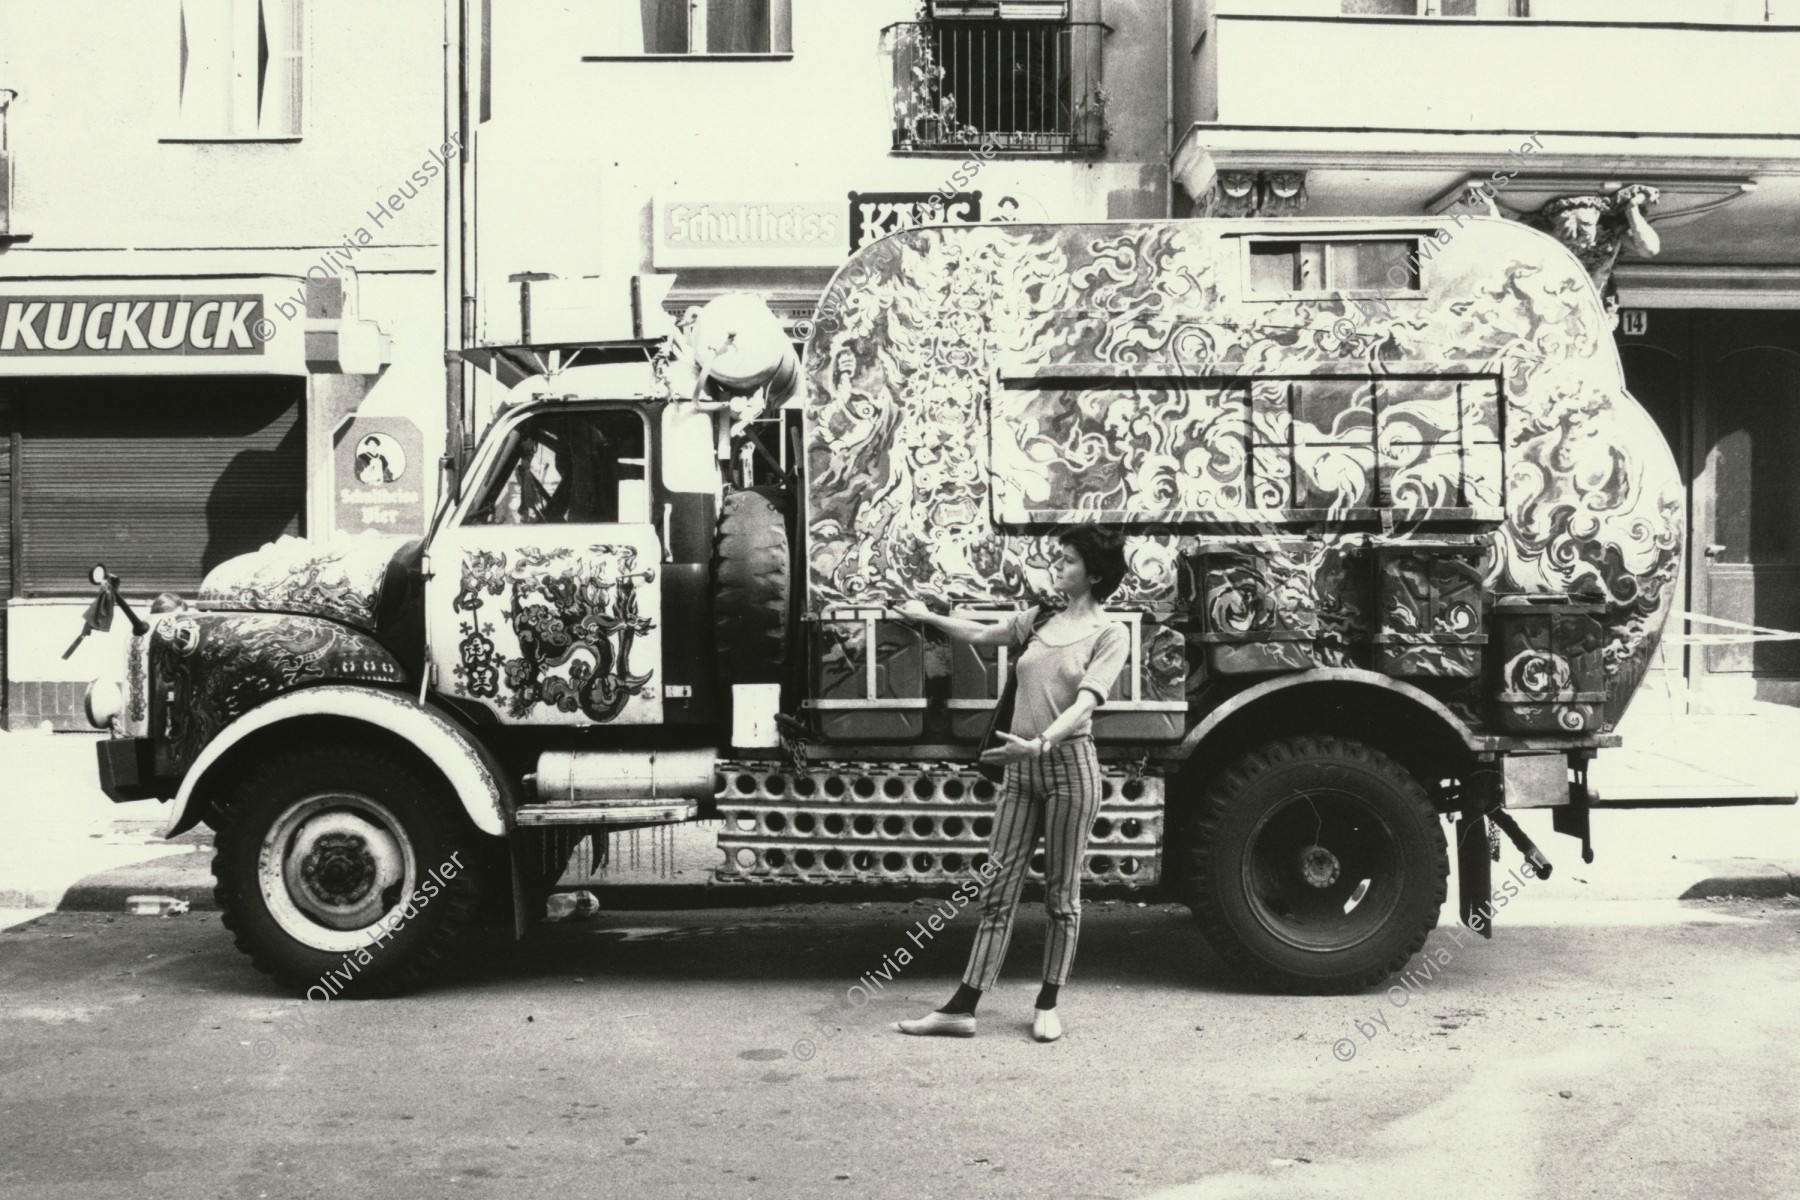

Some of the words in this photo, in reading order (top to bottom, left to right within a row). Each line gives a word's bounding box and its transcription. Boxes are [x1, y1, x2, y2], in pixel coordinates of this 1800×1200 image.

[670, 205, 837, 242] Schultheiss
[0, 301, 259, 350] KUCKUCK
[1626, 312, 1643, 332] 14
